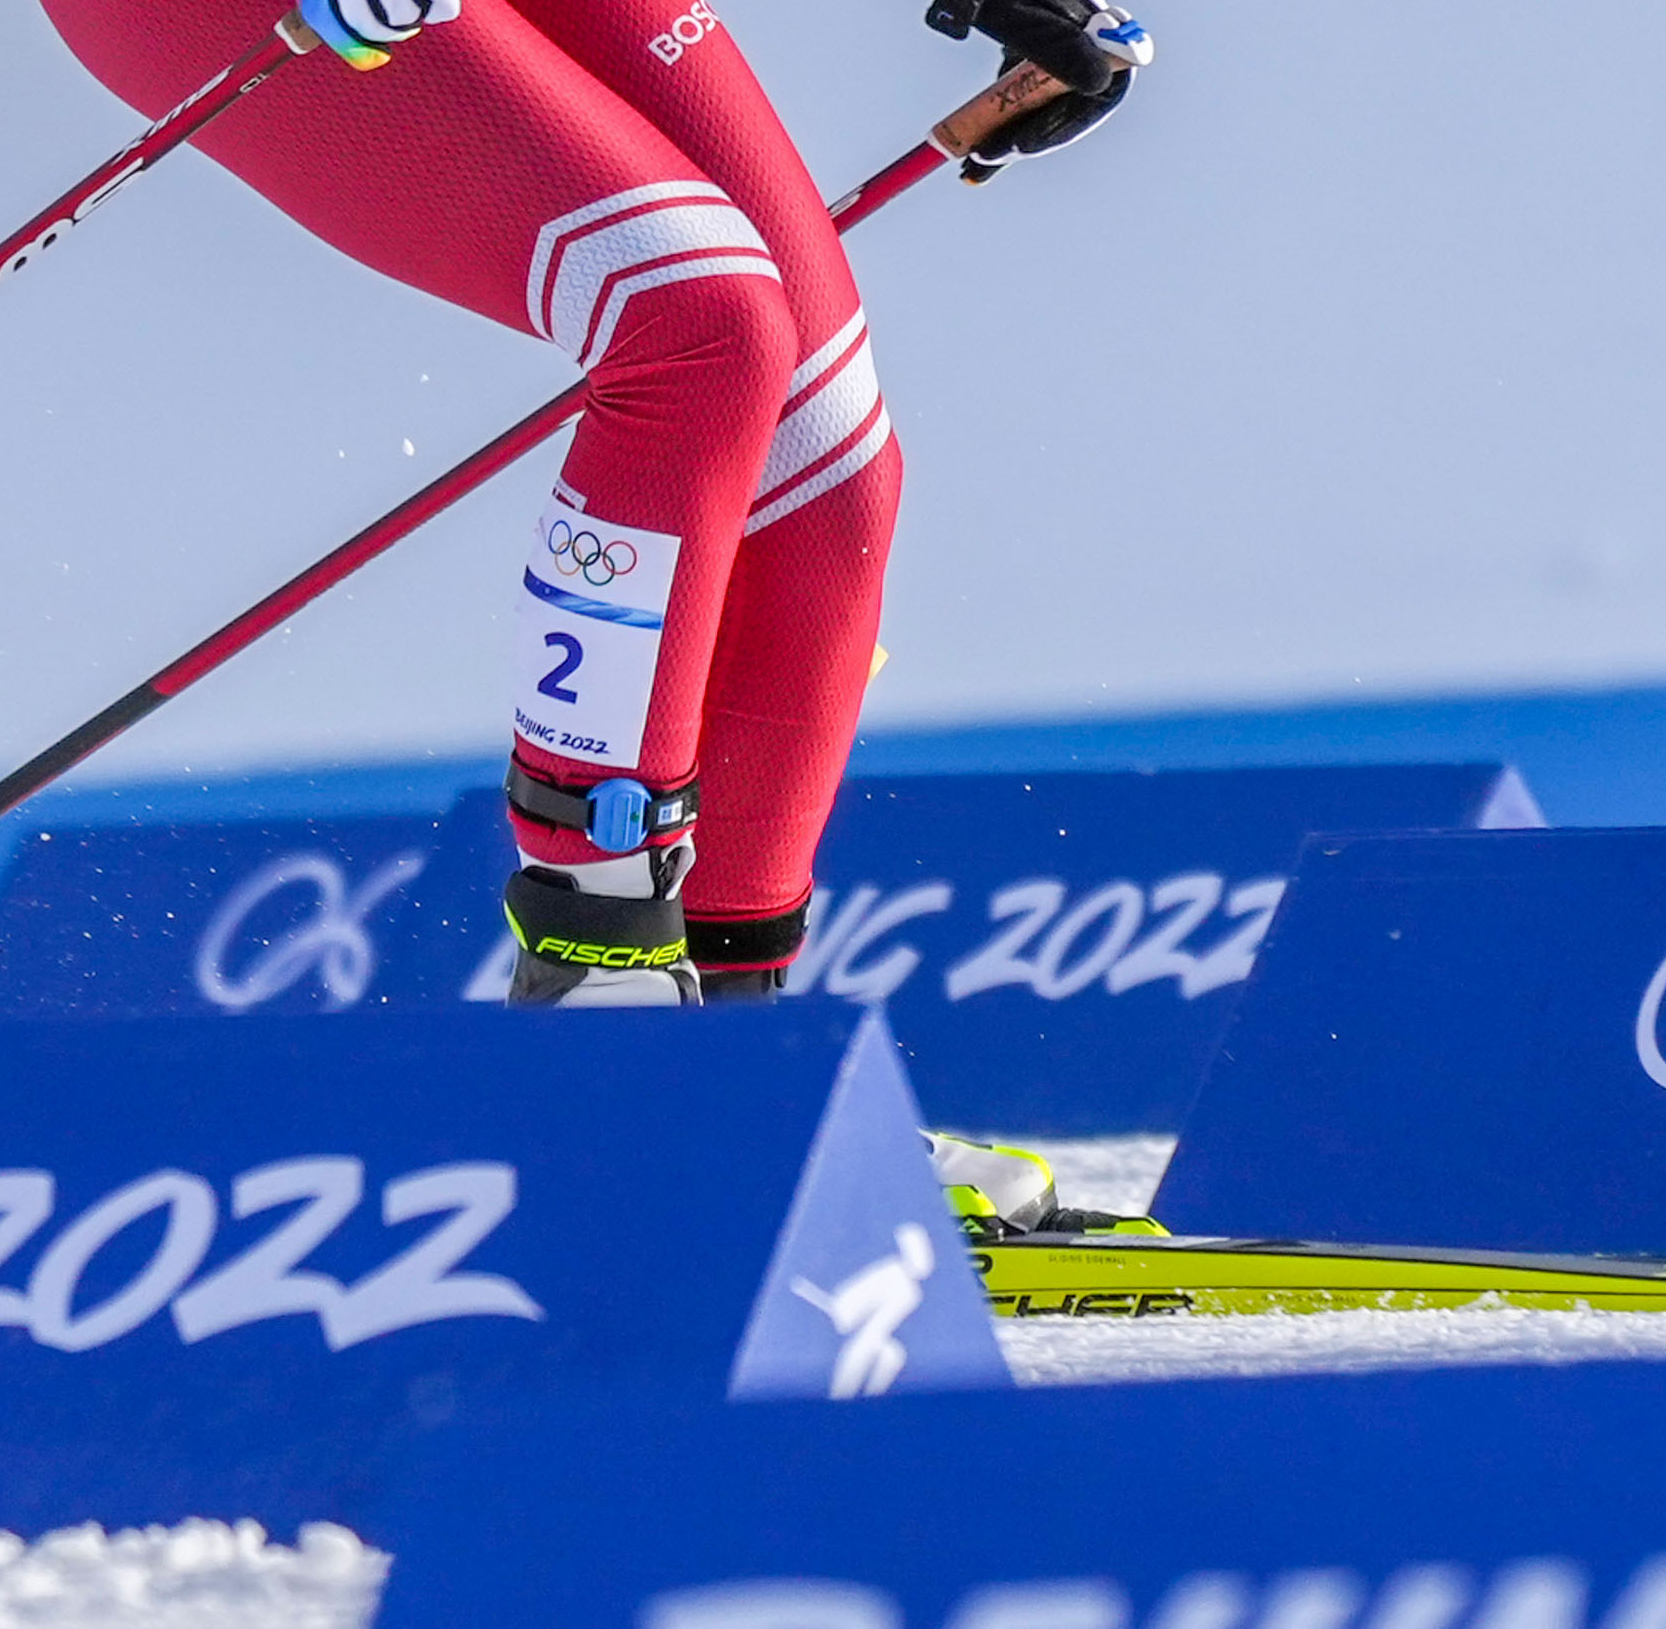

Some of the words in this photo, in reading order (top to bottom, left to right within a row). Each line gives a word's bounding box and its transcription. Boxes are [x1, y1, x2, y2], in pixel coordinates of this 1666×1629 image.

[537, 631, 584, 705] 2
[559, 732, 612, 754] 2022
[535, 936, 686, 968] FISCHER
